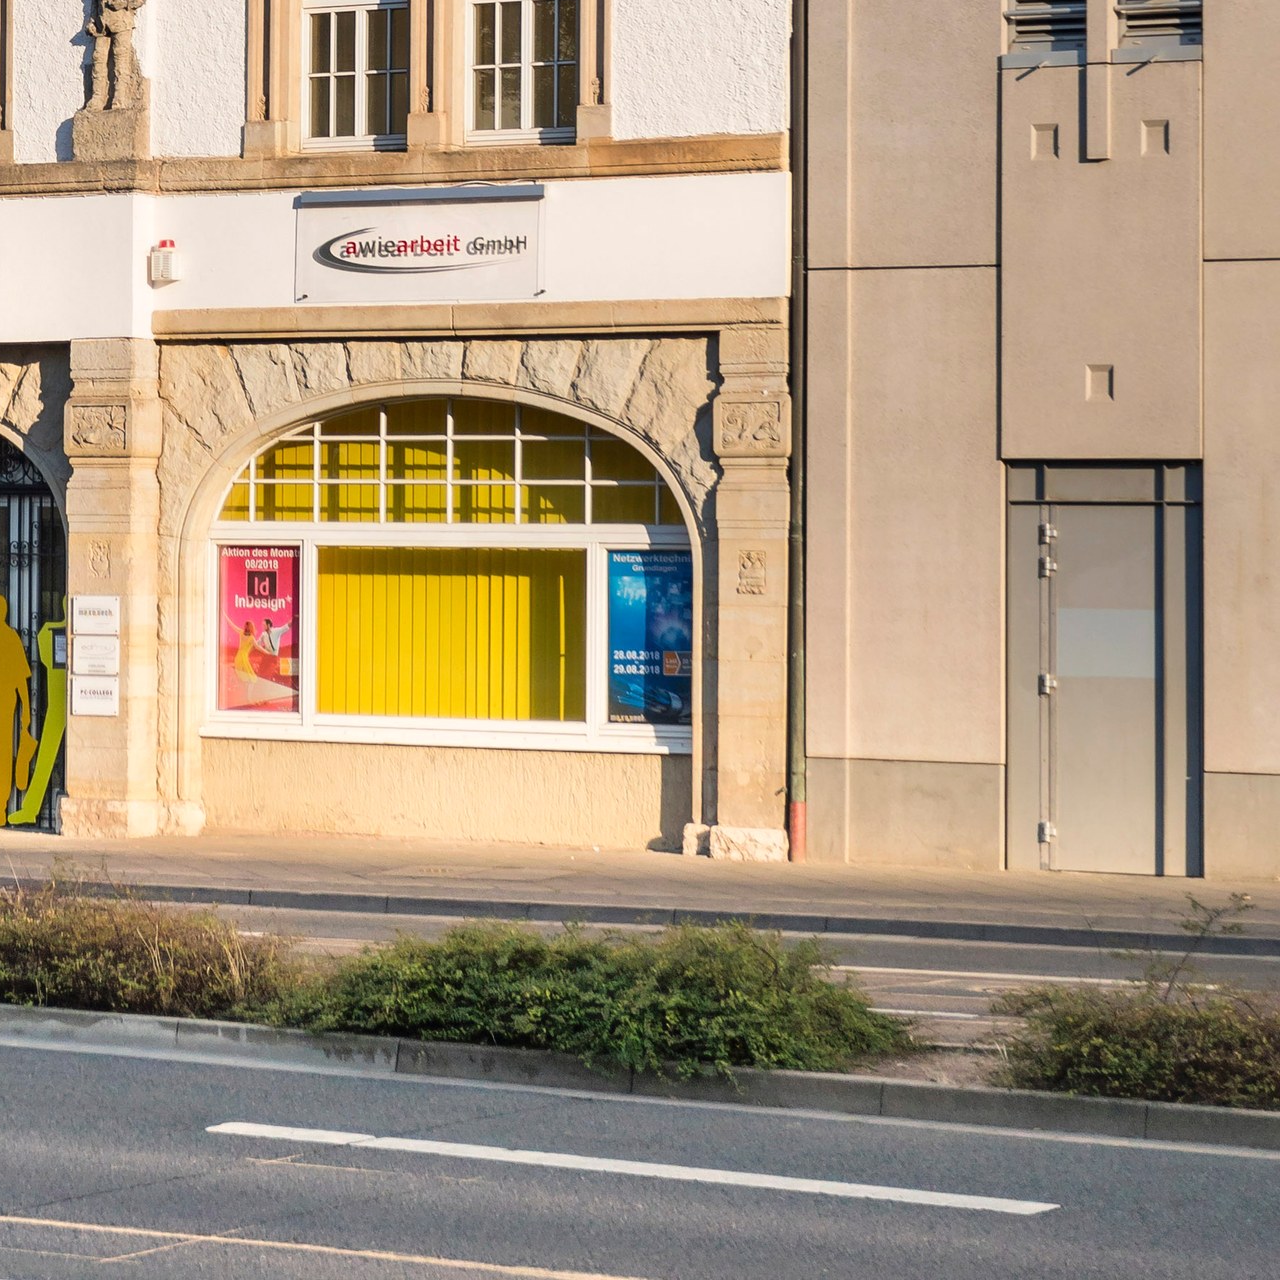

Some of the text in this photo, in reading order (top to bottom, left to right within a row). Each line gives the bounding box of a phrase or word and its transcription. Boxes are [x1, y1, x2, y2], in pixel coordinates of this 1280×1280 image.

[345, 234, 528, 255] awiearbeit GmbH
[222, 547, 250, 557] Aktion
[252, 548, 268, 557] des
[245, 559, 279, 569] 08/2018
[632, 564, 677, 572] Grundlagen
[254, 576, 270, 596] Id
[613, 650, 660, 660] 28.08.2018
[613, 664, 660, 674] 29.08.2018
